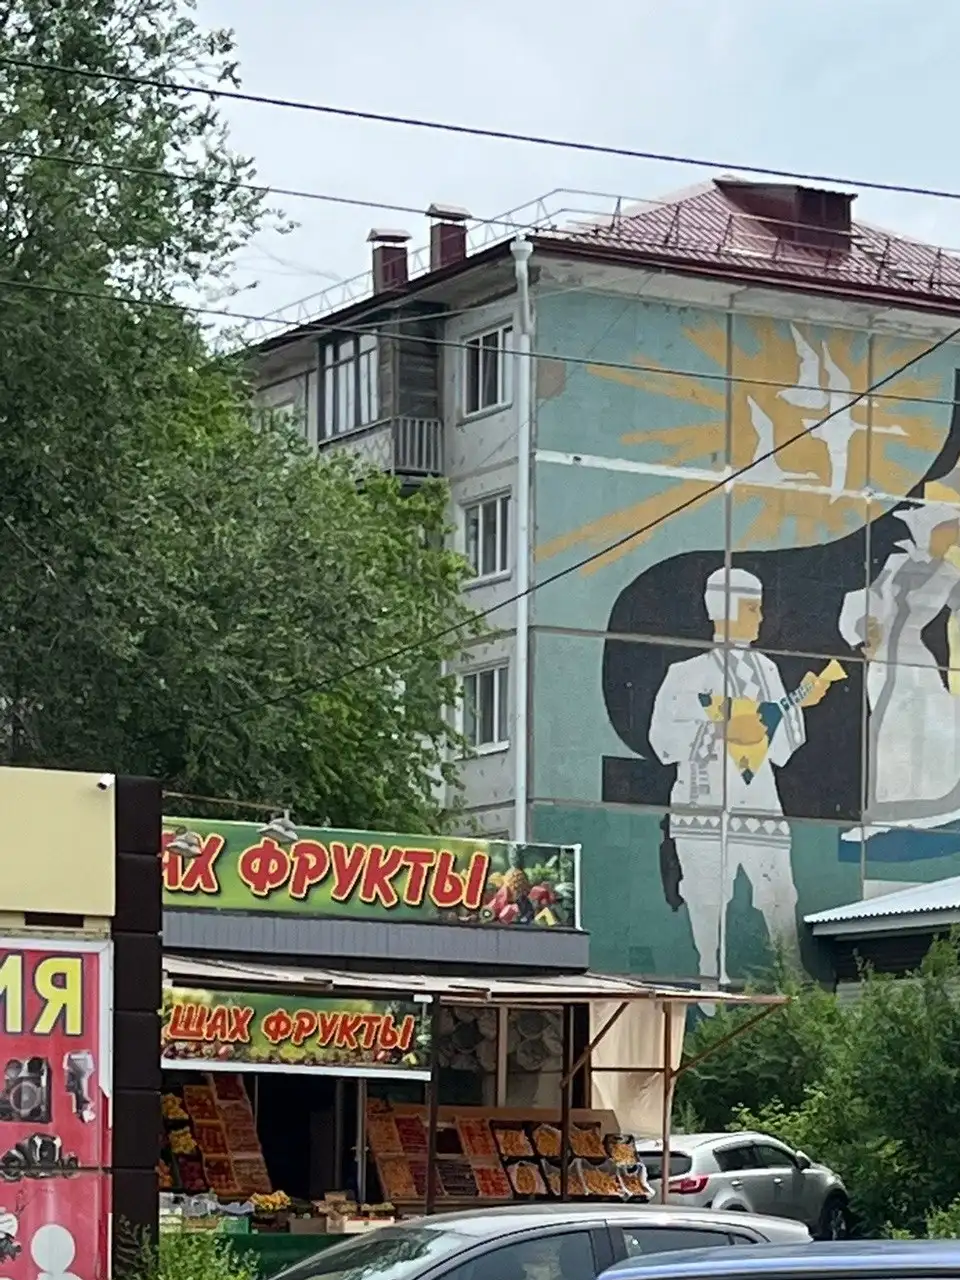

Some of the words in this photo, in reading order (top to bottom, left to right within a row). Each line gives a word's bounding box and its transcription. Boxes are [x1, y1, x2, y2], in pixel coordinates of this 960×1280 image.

[238, 838, 490, 909] ФРУКТЫ
[168, 1003, 253, 1042] ШАХ
[261, 1008, 415, 1050] ФРУКТЫ
